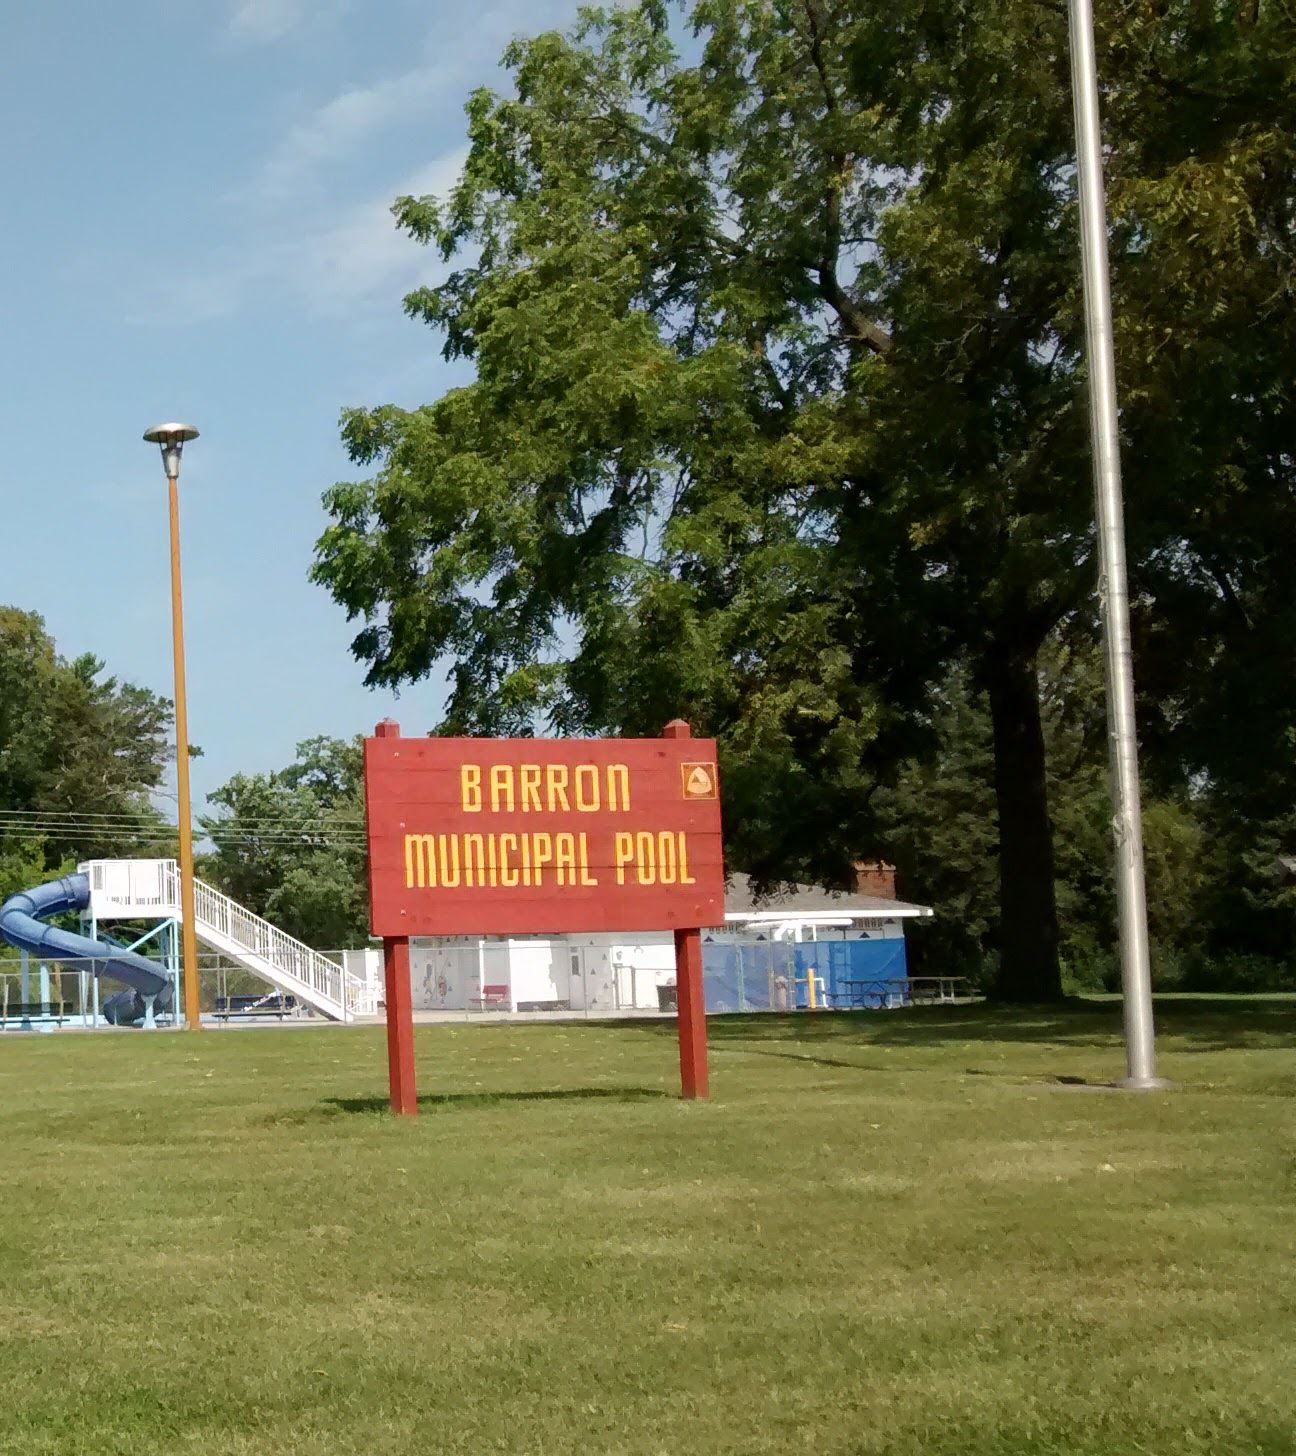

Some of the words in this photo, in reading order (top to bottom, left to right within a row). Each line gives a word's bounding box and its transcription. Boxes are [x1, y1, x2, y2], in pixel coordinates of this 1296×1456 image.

[461, 764, 630, 813] BARRON
[405, 832, 598, 888] MUNICIPAL
[615, 830, 696, 886] POOL
